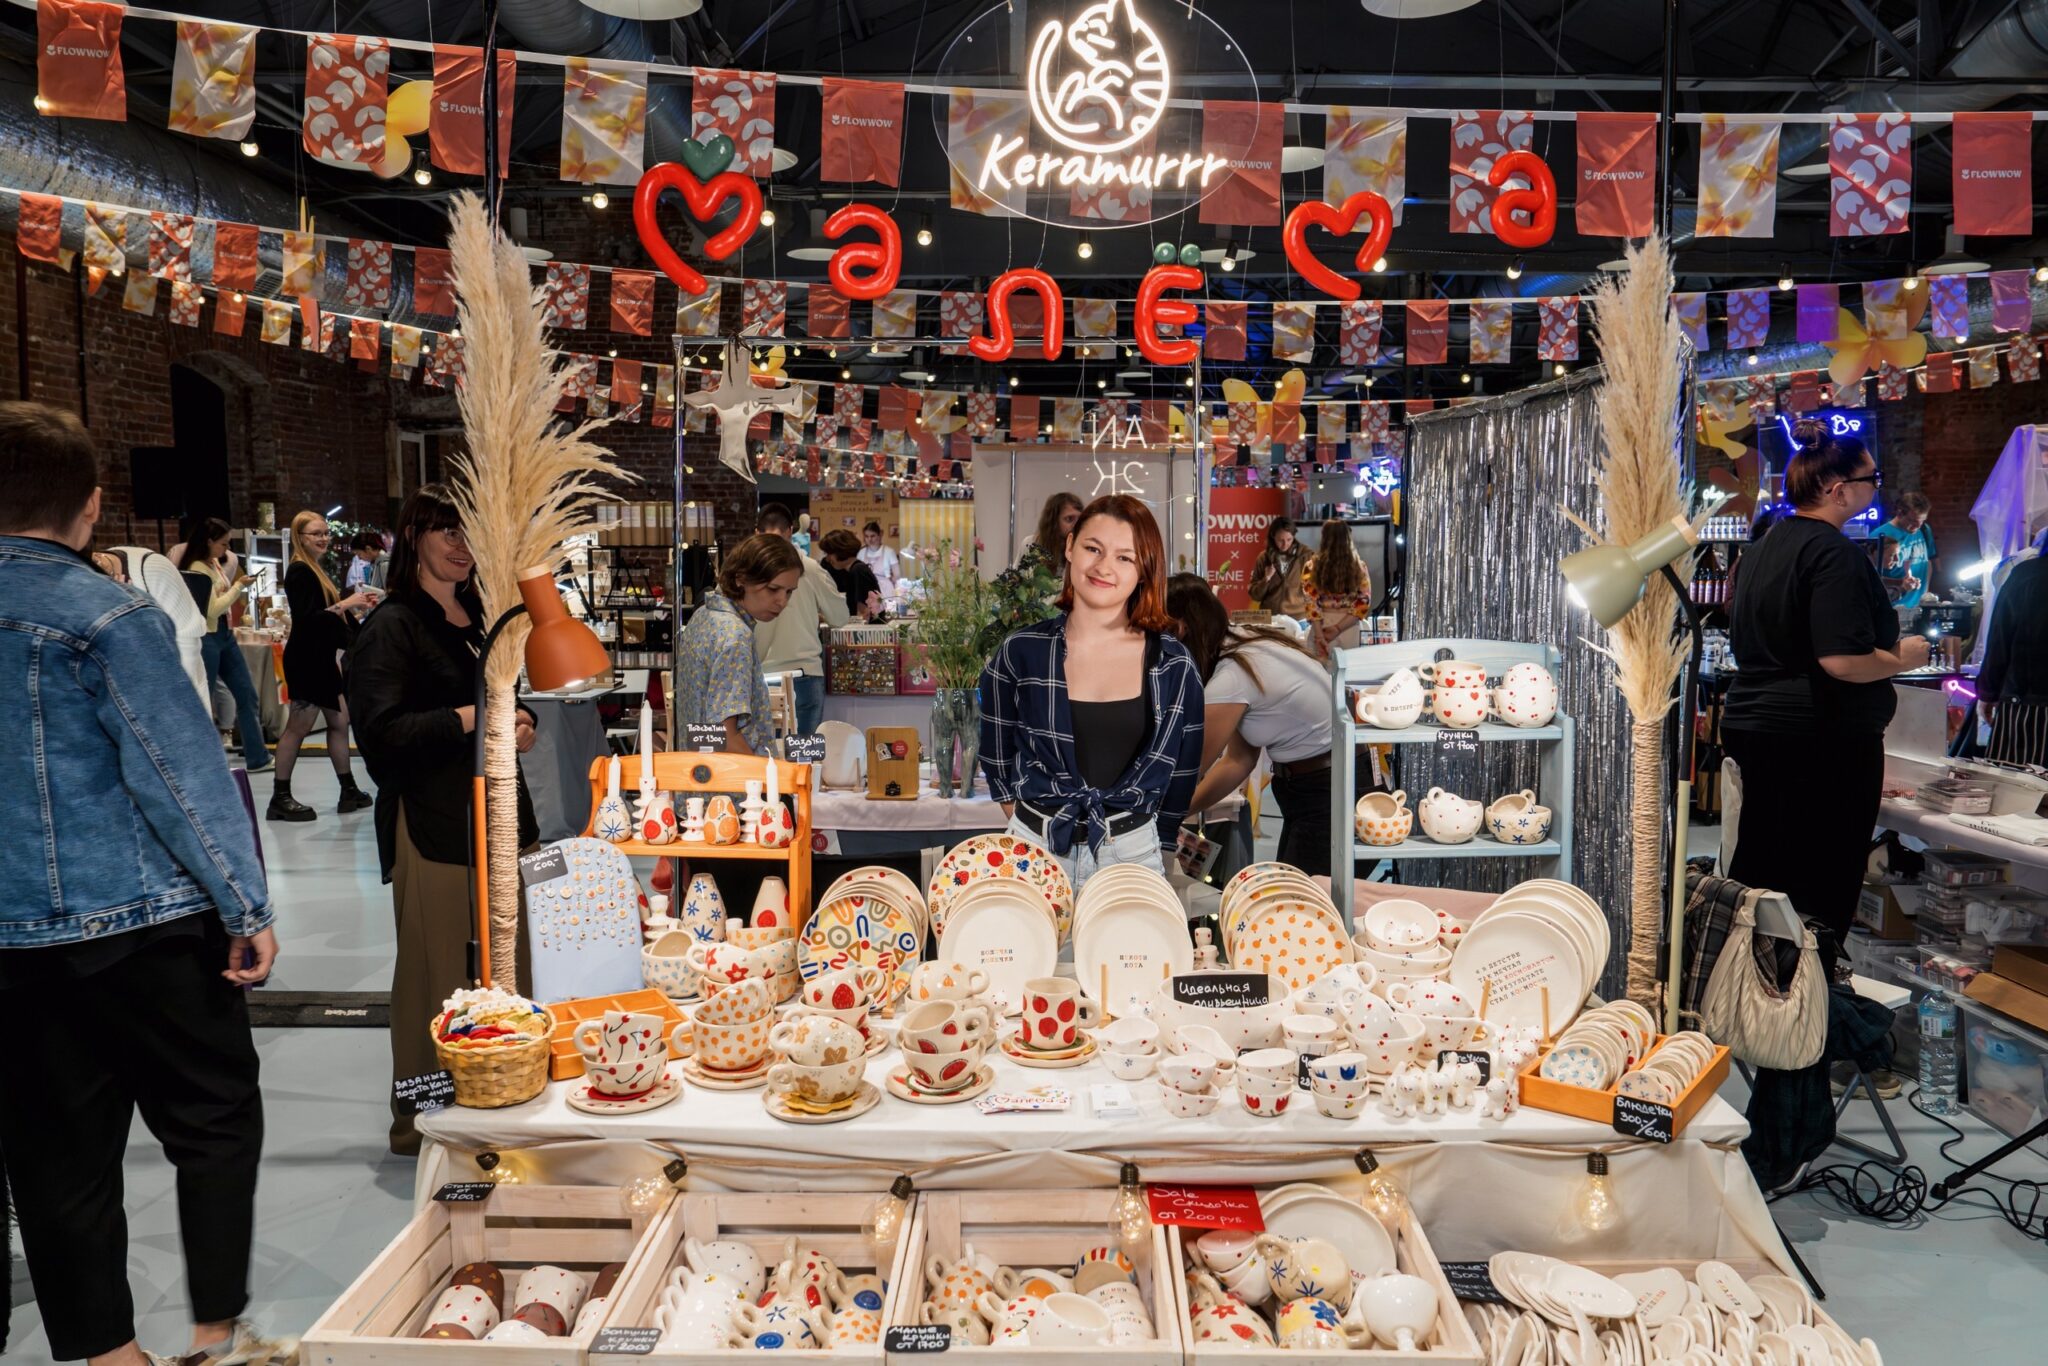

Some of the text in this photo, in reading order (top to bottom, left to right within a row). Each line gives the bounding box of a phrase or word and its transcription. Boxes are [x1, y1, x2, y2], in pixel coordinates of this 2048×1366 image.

[57, 46, 110, 58] FLOWWOW
[841, 116, 893, 128] FLOWWOW
[978, 132, 1228, 190] Keramurrr
[1593, 170, 1645, 180] FLOWWOW
[1971, 169, 2022, 179] FLOWWOW
[1209, 530, 1260, 543] market
[1488, 951, 1521, 970] ДЕТСТВЕ
[1179, 981, 1250, 996] Идеальная
[1152, 1187, 1198, 1199] Sale
[1183, 1209, 1214, 1221] 200
